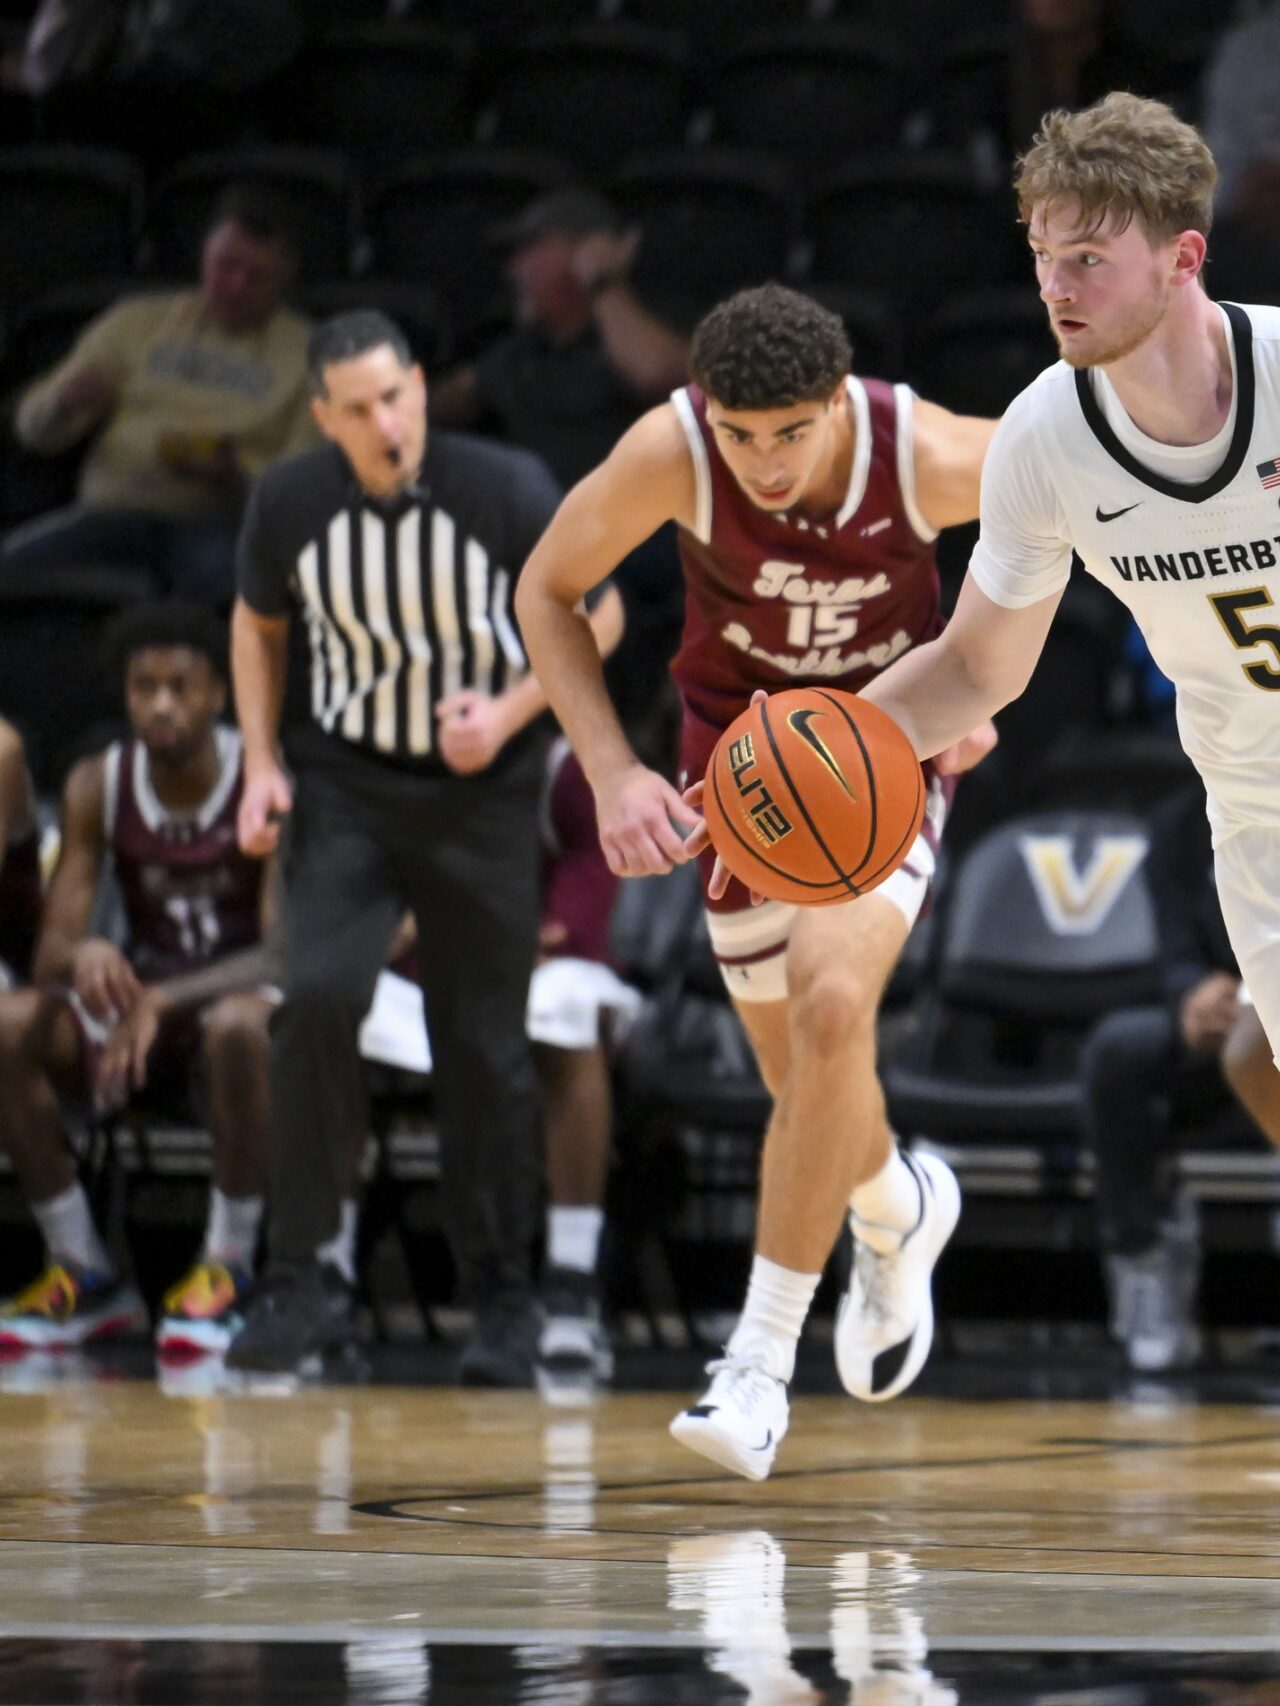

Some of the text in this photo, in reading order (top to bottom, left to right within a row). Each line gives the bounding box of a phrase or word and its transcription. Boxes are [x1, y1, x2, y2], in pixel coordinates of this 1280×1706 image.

[753, 560, 891, 604] Texas
[787, 605, 862, 648] 15
[729, 732, 795, 844] ELITE
[1018, 834, 1149, 935] V
